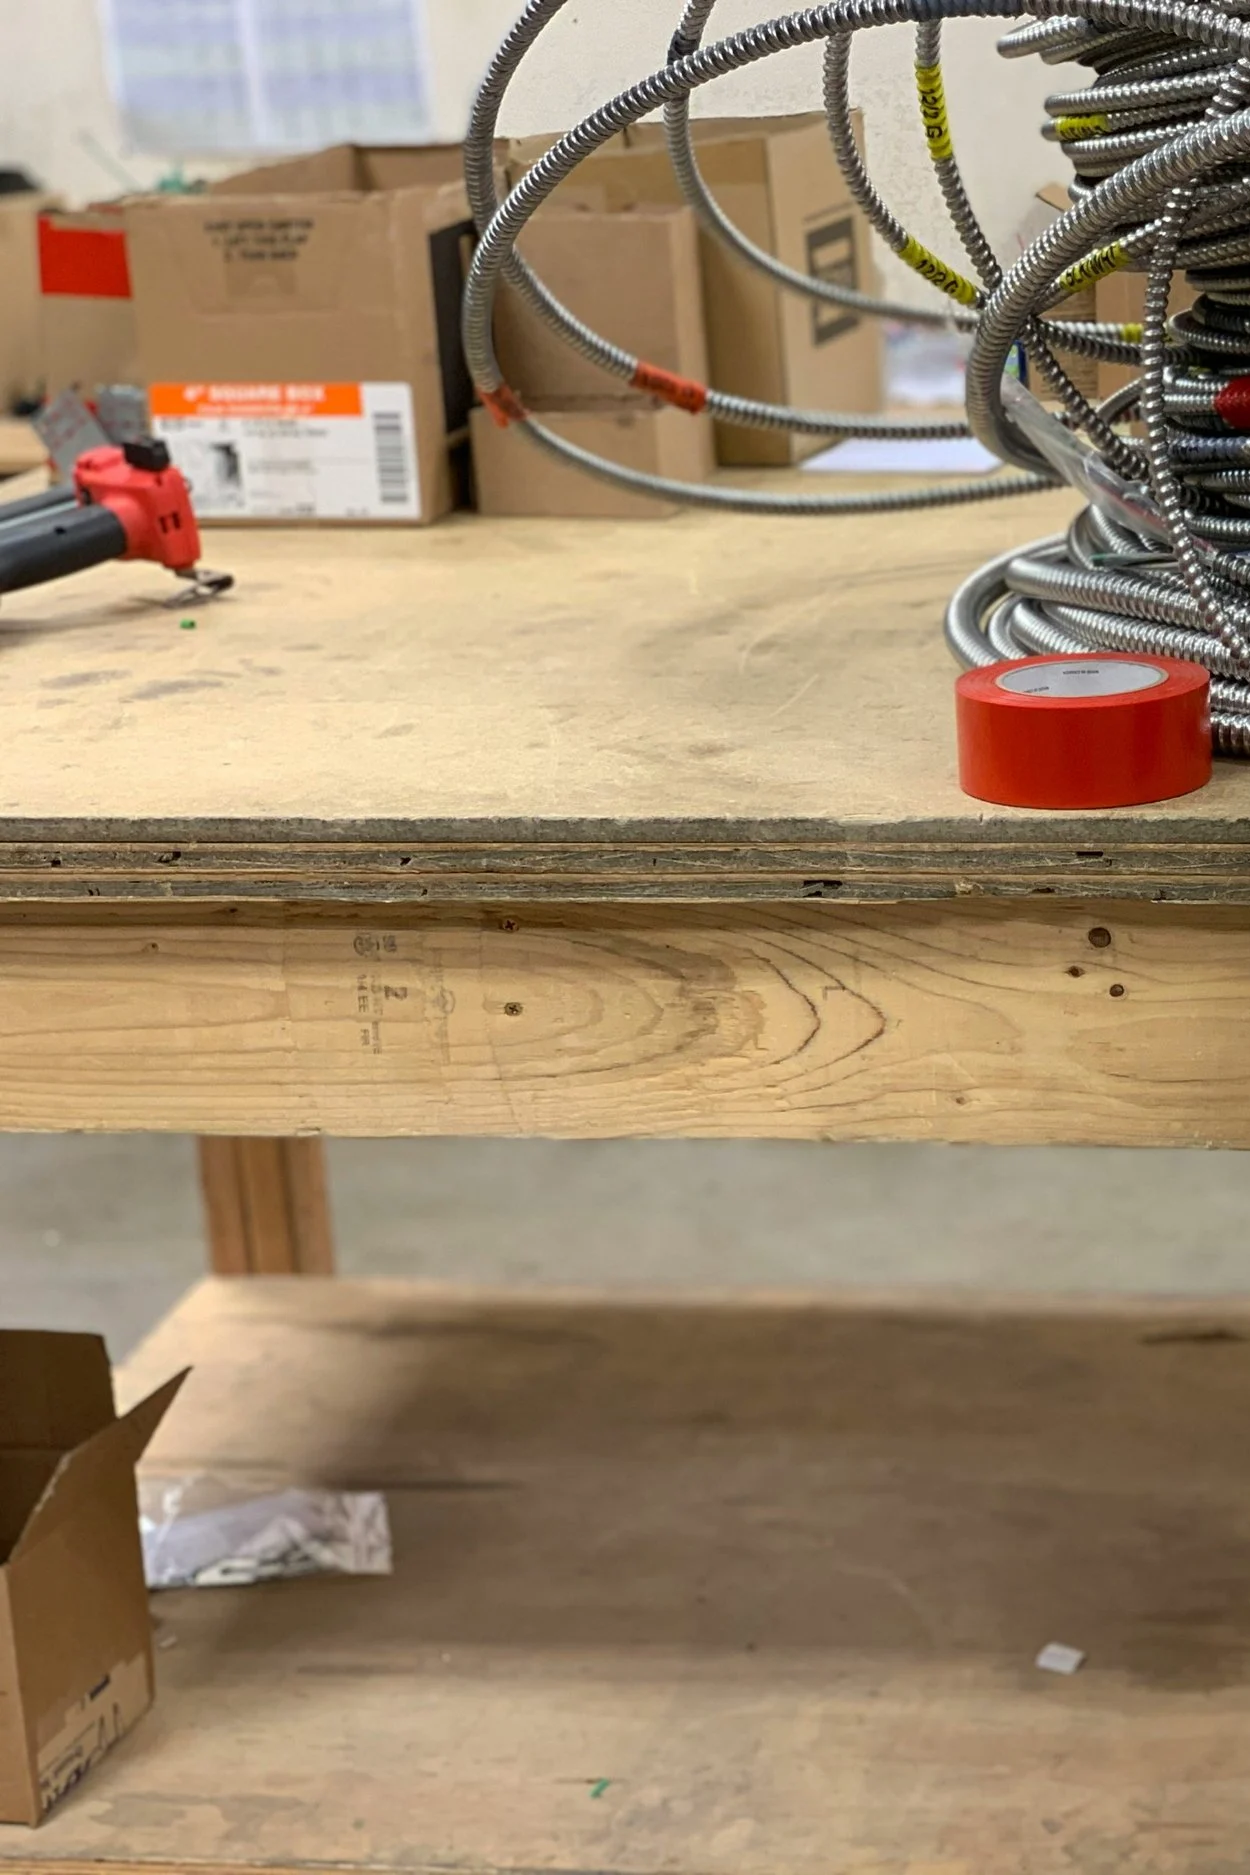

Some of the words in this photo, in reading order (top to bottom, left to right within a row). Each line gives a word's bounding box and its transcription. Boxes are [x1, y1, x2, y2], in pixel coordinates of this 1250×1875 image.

[920, 88, 942, 120] 12/2
[925, 124, 944, 139] G
[915, 257, 944, 287] 12/2
